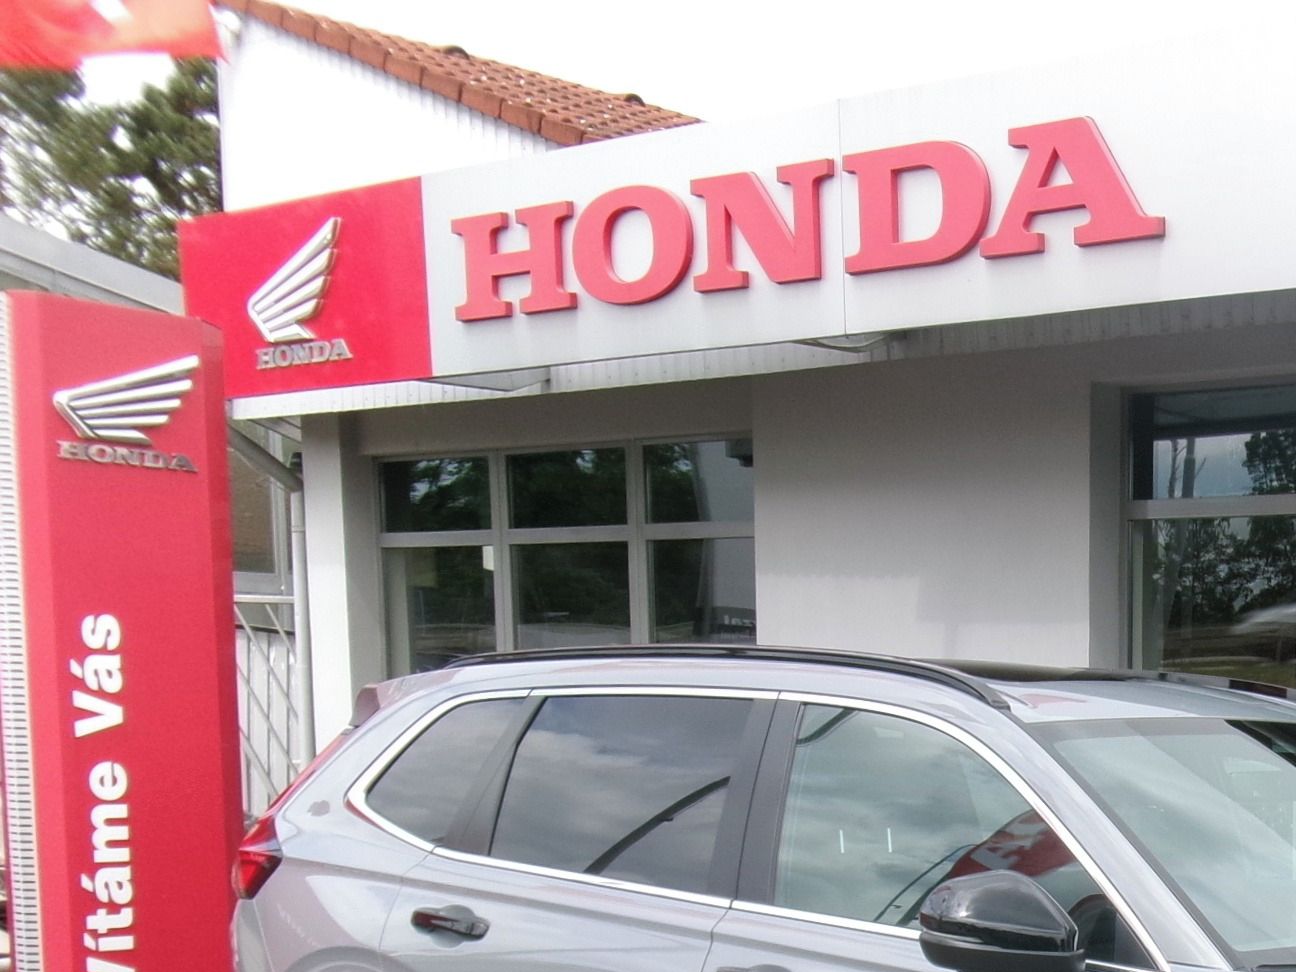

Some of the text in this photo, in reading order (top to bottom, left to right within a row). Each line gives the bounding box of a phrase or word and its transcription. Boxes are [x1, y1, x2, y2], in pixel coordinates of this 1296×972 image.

[450, 114, 1166, 324] HONDA
[256, 338, 352, 371] HONDA
[56, 440, 198, 474] HONDA
[70, 612, 126, 739] Vás
